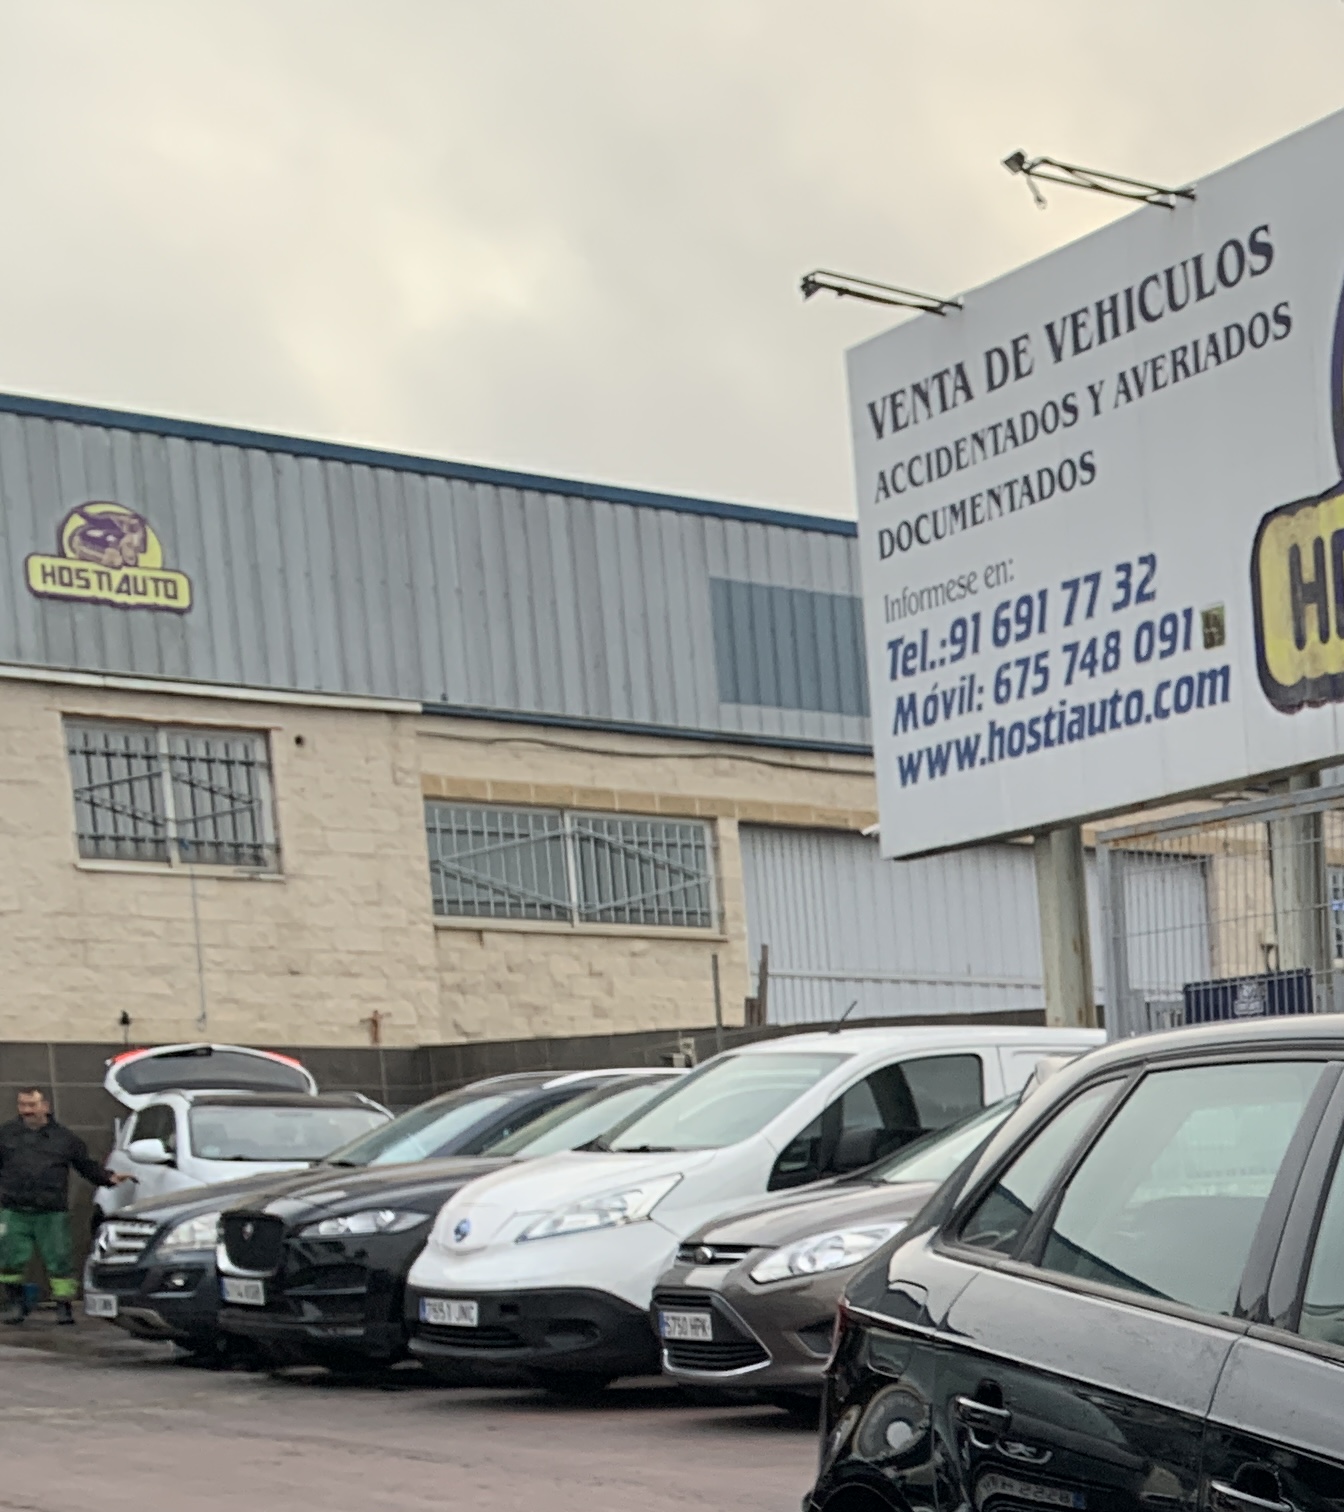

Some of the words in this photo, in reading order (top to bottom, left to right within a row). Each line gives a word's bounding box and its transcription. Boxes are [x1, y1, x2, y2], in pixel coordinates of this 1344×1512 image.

[868, 362, 975, 440] VENTA
[985, 334, 1035, 393] DE
[1045, 224, 1275, 363] VEHICULOS
[874, 392, 1080, 503] ACCIDENTADOS
[1088, 381, 1107, 416] Y
[1113, 302, 1293, 409] AVERIADOS
[879, 451, 1097, 560] DOCUMENTADOS
[41, 563, 178, 600] HOSTIAUTO
[984, 558, 1015, 590] en:
[992, 588, 1048, 648] 691
[1061, 571, 1102, 627] 77
[1112, 553, 1157, 612] 32
[893, 674, 984, 736] Móvil:
[994, 650, 1050, 704] 675
[1062, 630, 1121, 686] 748
[1134, 606, 1194, 664] 091
[898, 665, 1231, 788] www.hostiauto.com
